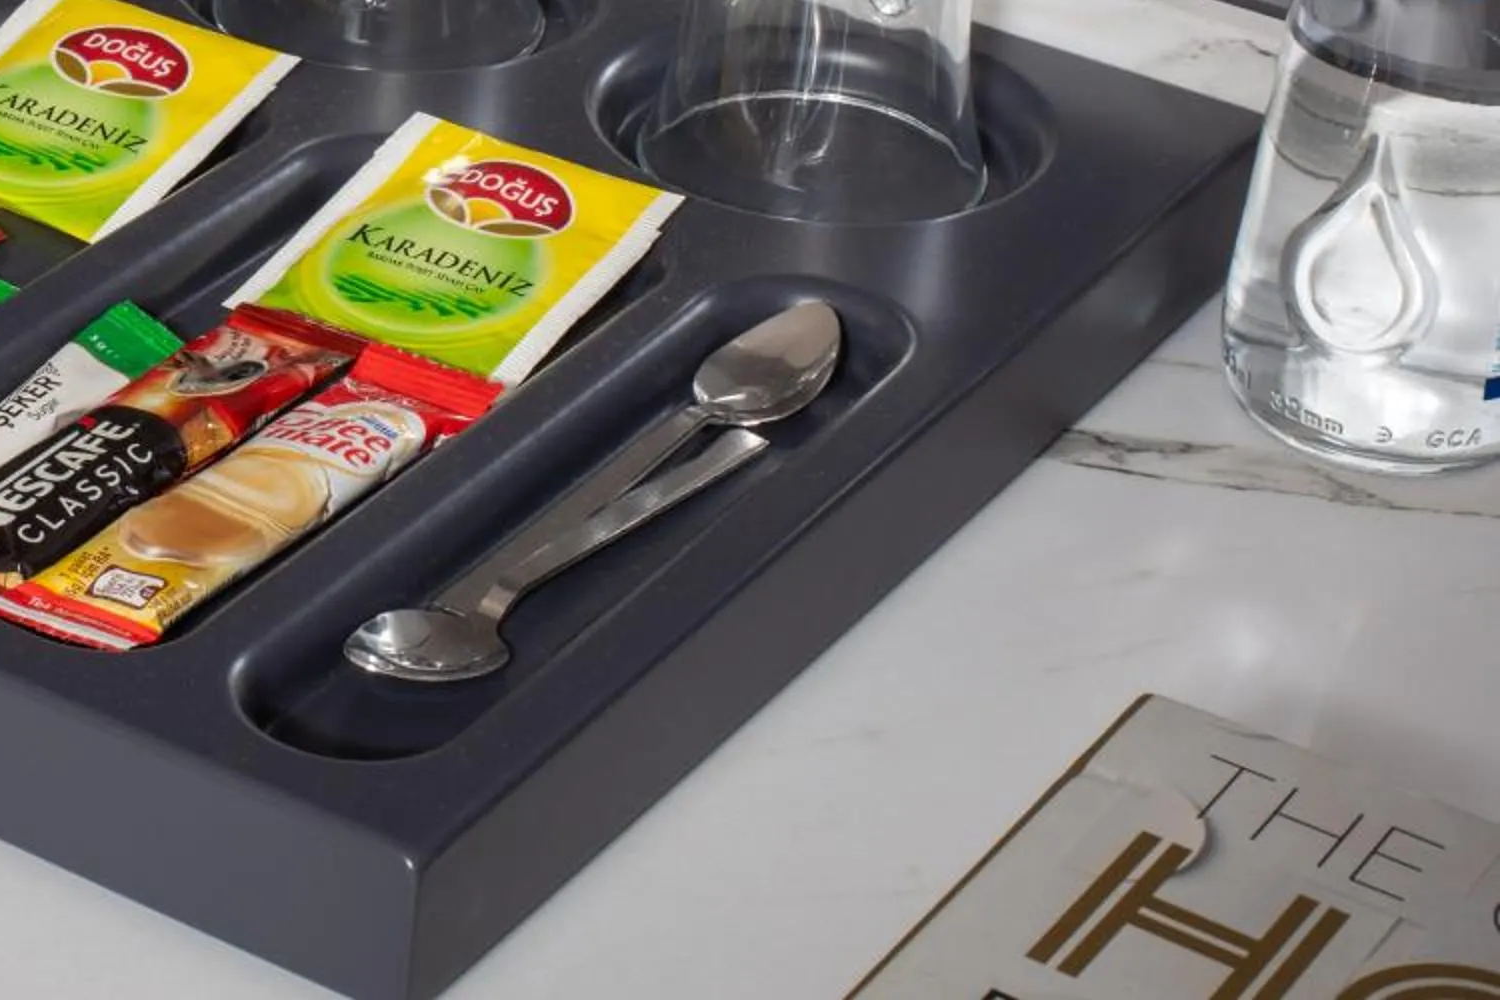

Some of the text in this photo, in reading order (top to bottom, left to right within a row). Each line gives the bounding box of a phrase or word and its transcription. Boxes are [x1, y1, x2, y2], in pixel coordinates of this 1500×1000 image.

[83, 32, 177, 78] DOĞUŞ
[456, 168, 560, 219] DOĞUŞ
[347, 223, 535, 298] KARADENİZ
[263, 426, 371, 466] mate
[17, 443, 153, 543] CLASSIC
[1196, 754, 1446, 902] THE
[1025, 830, 1500, 1000] H
